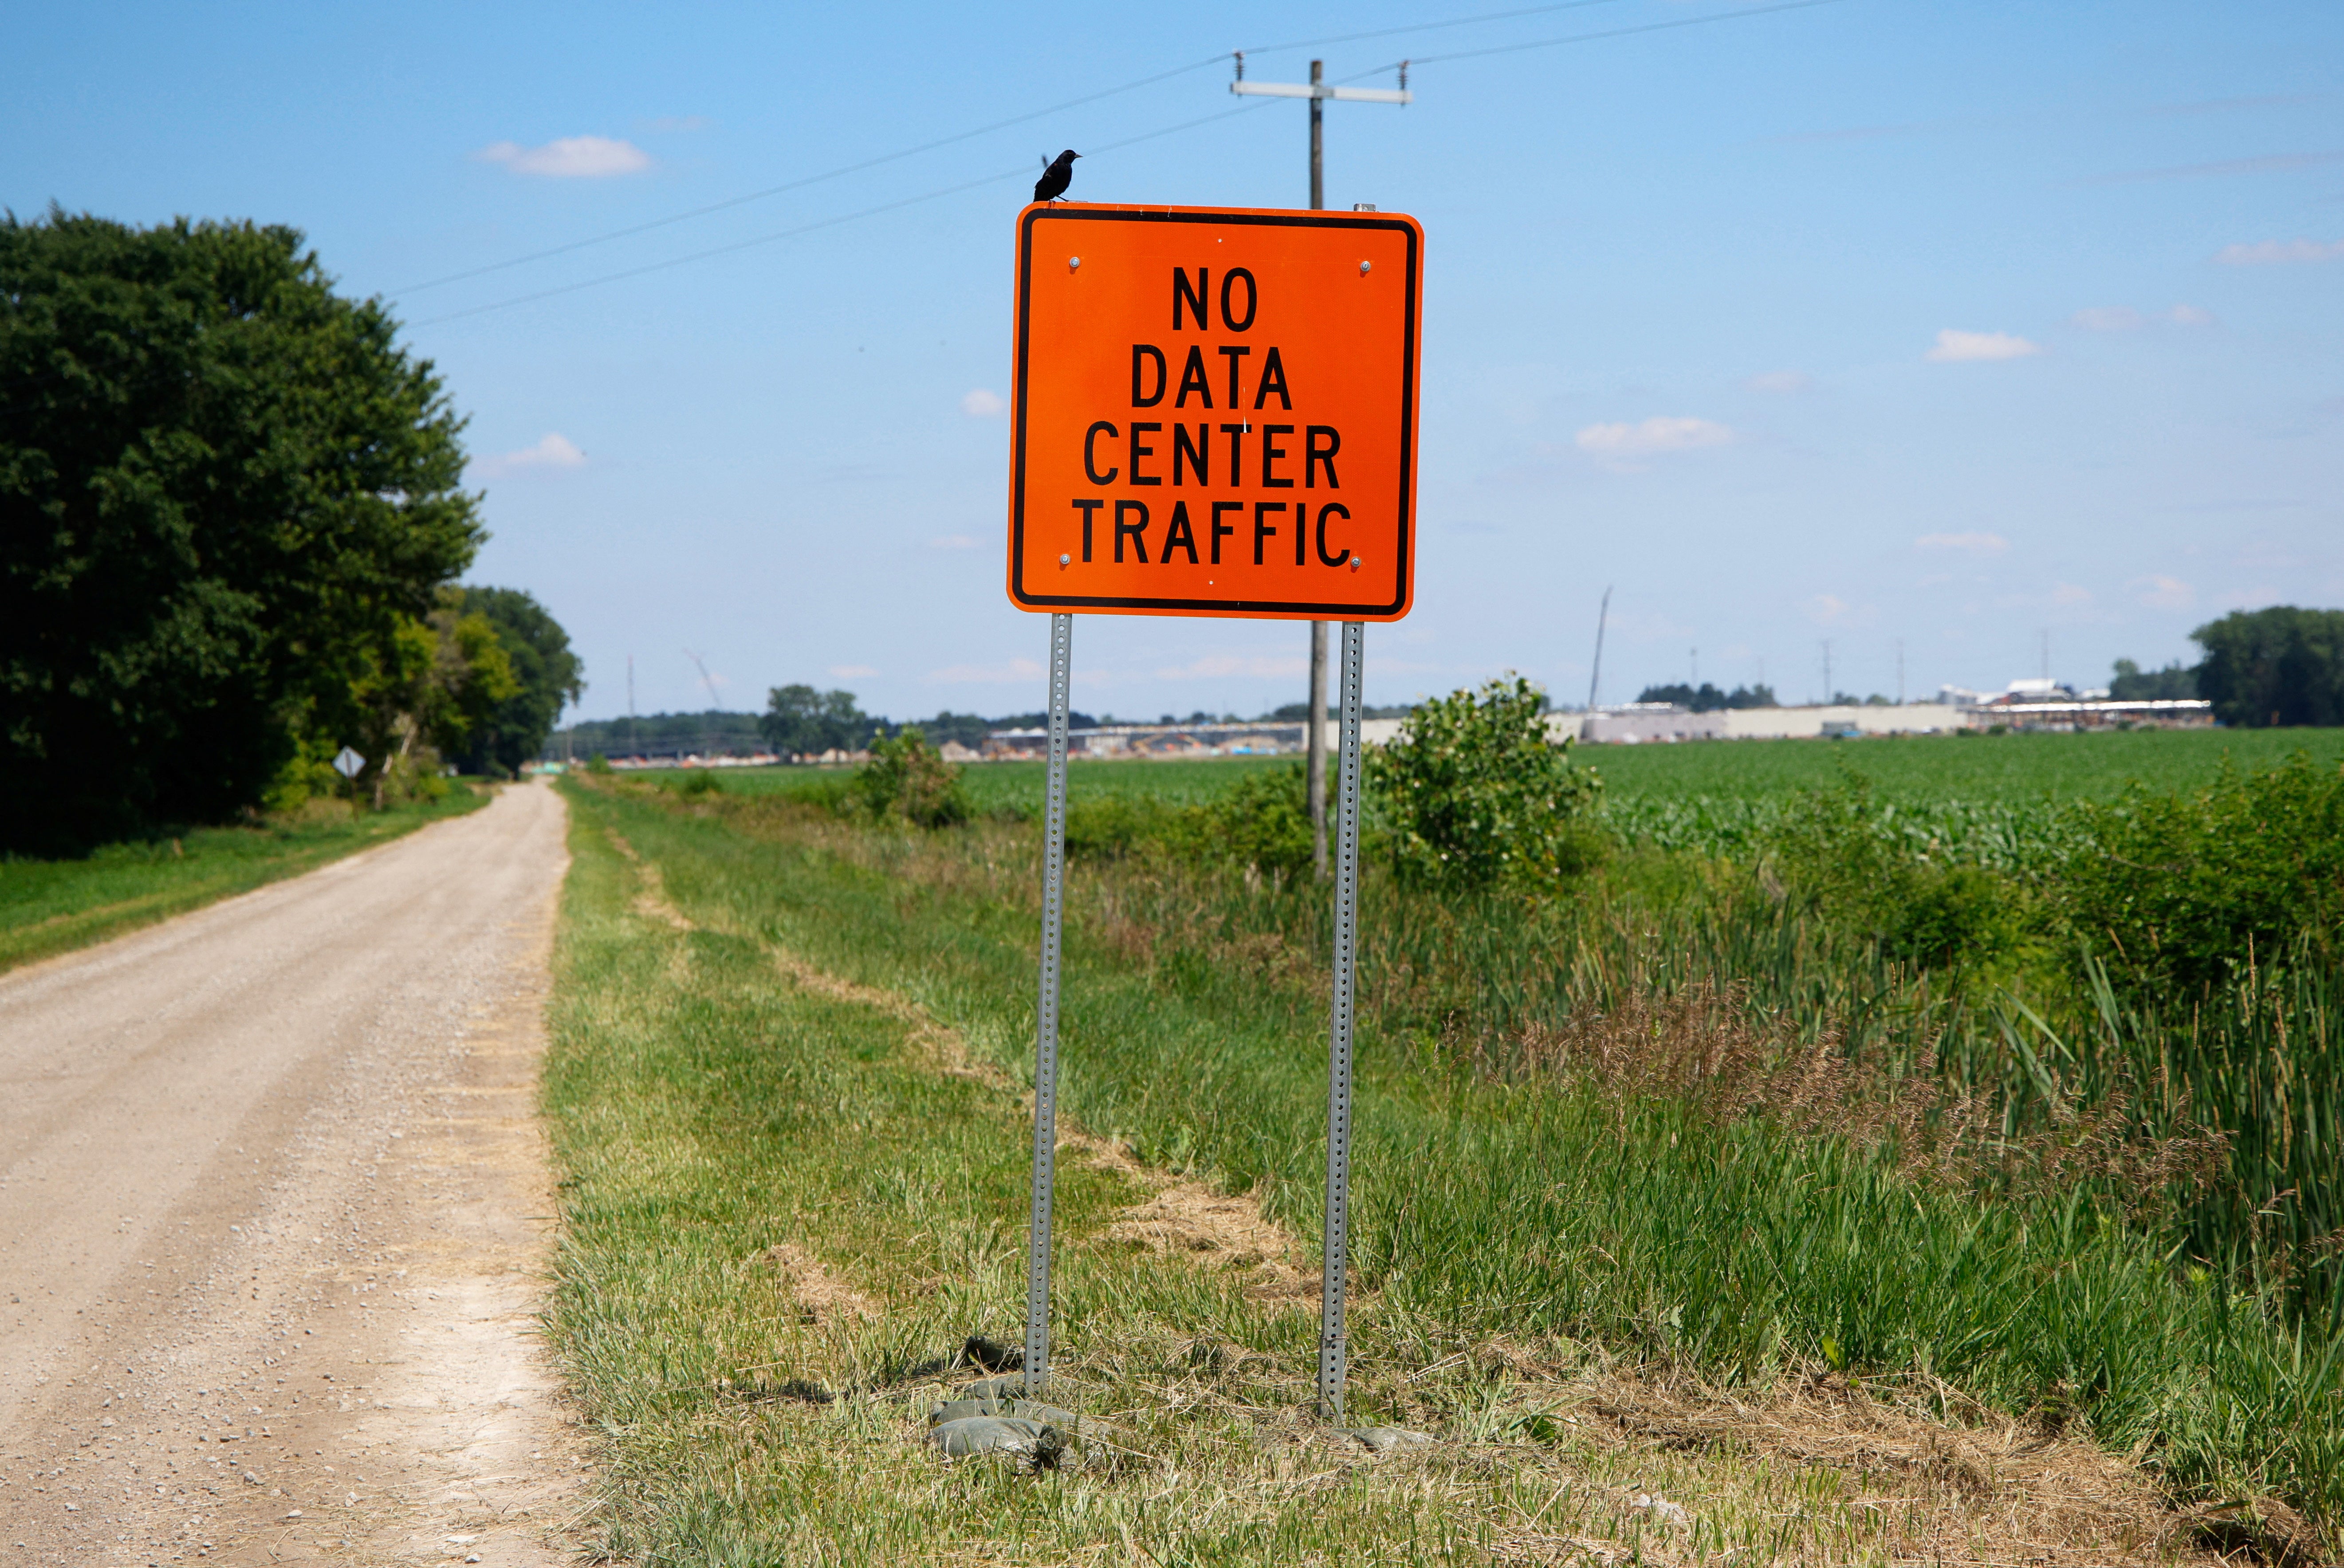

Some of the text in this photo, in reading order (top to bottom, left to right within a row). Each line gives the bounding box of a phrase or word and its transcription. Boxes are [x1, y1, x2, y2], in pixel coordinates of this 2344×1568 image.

[1172, 267, 1257, 332] NO
[1132, 344, 1292, 410] DATA
[1084, 420, 1341, 489] CENTER
[1072, 499, 1351, 567] TRAFFIC
